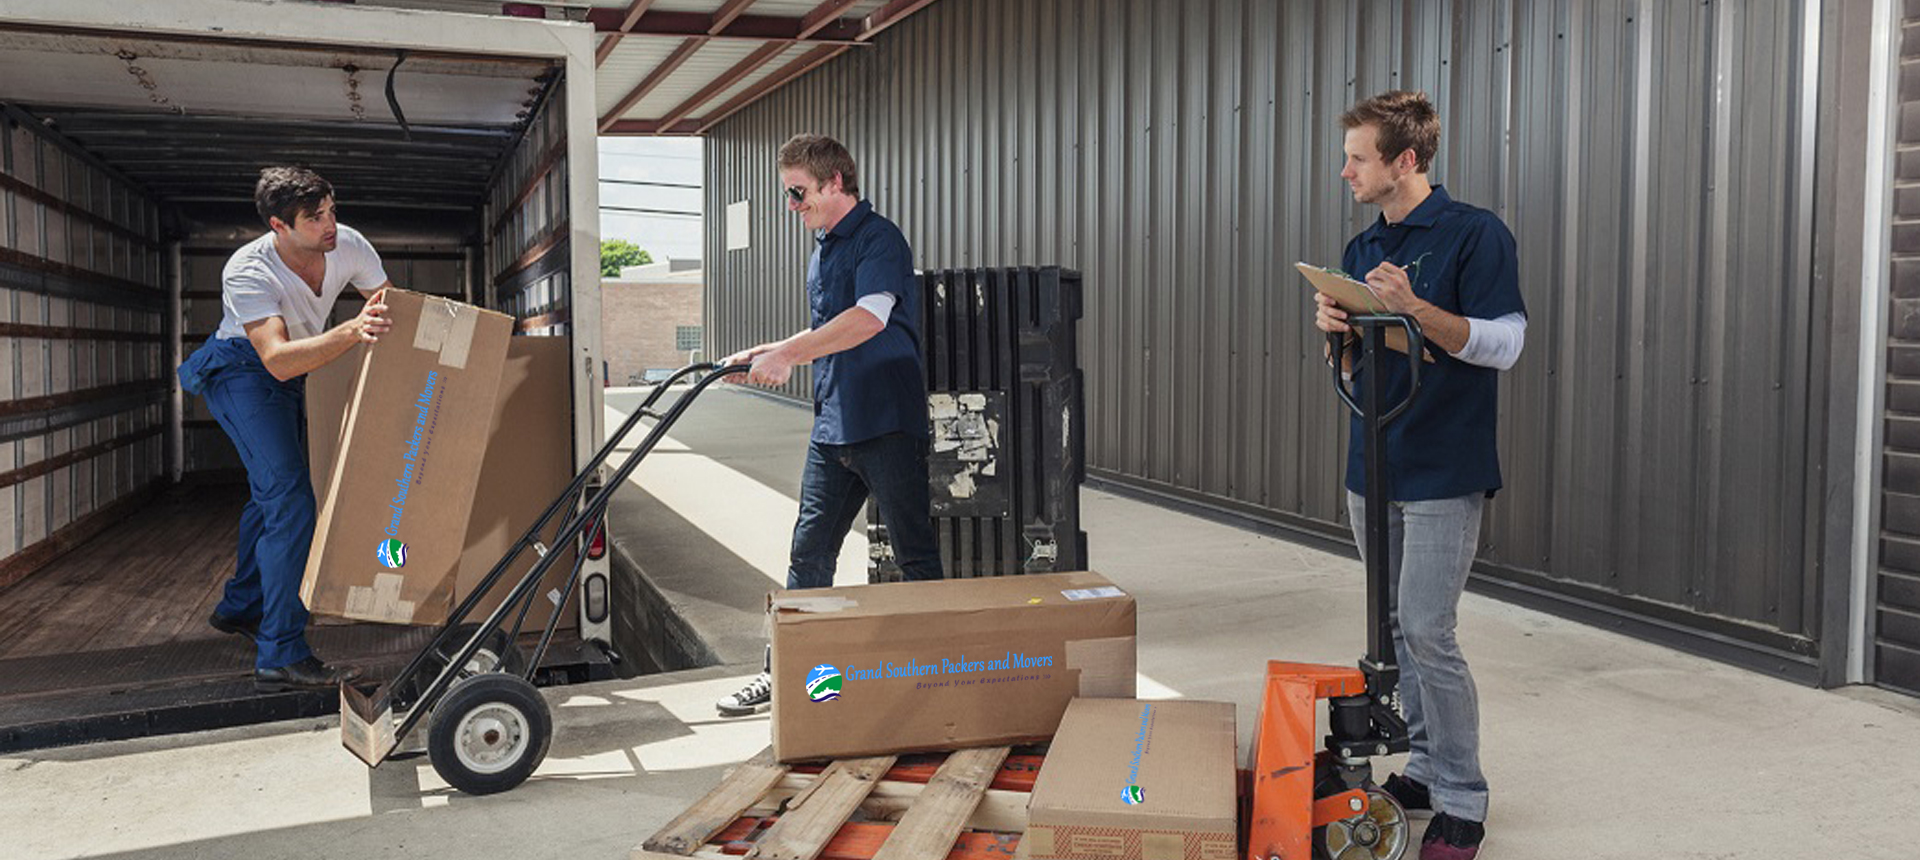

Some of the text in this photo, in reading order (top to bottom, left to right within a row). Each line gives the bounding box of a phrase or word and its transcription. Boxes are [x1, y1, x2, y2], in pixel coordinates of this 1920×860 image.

[384, 370, 439, 537] Grand Southern Packers and Movers
[845, 651, 1053, 682] Grand Southern Packers and Movers
[916, 674, 1040, 690] Beyond Your Expectations
